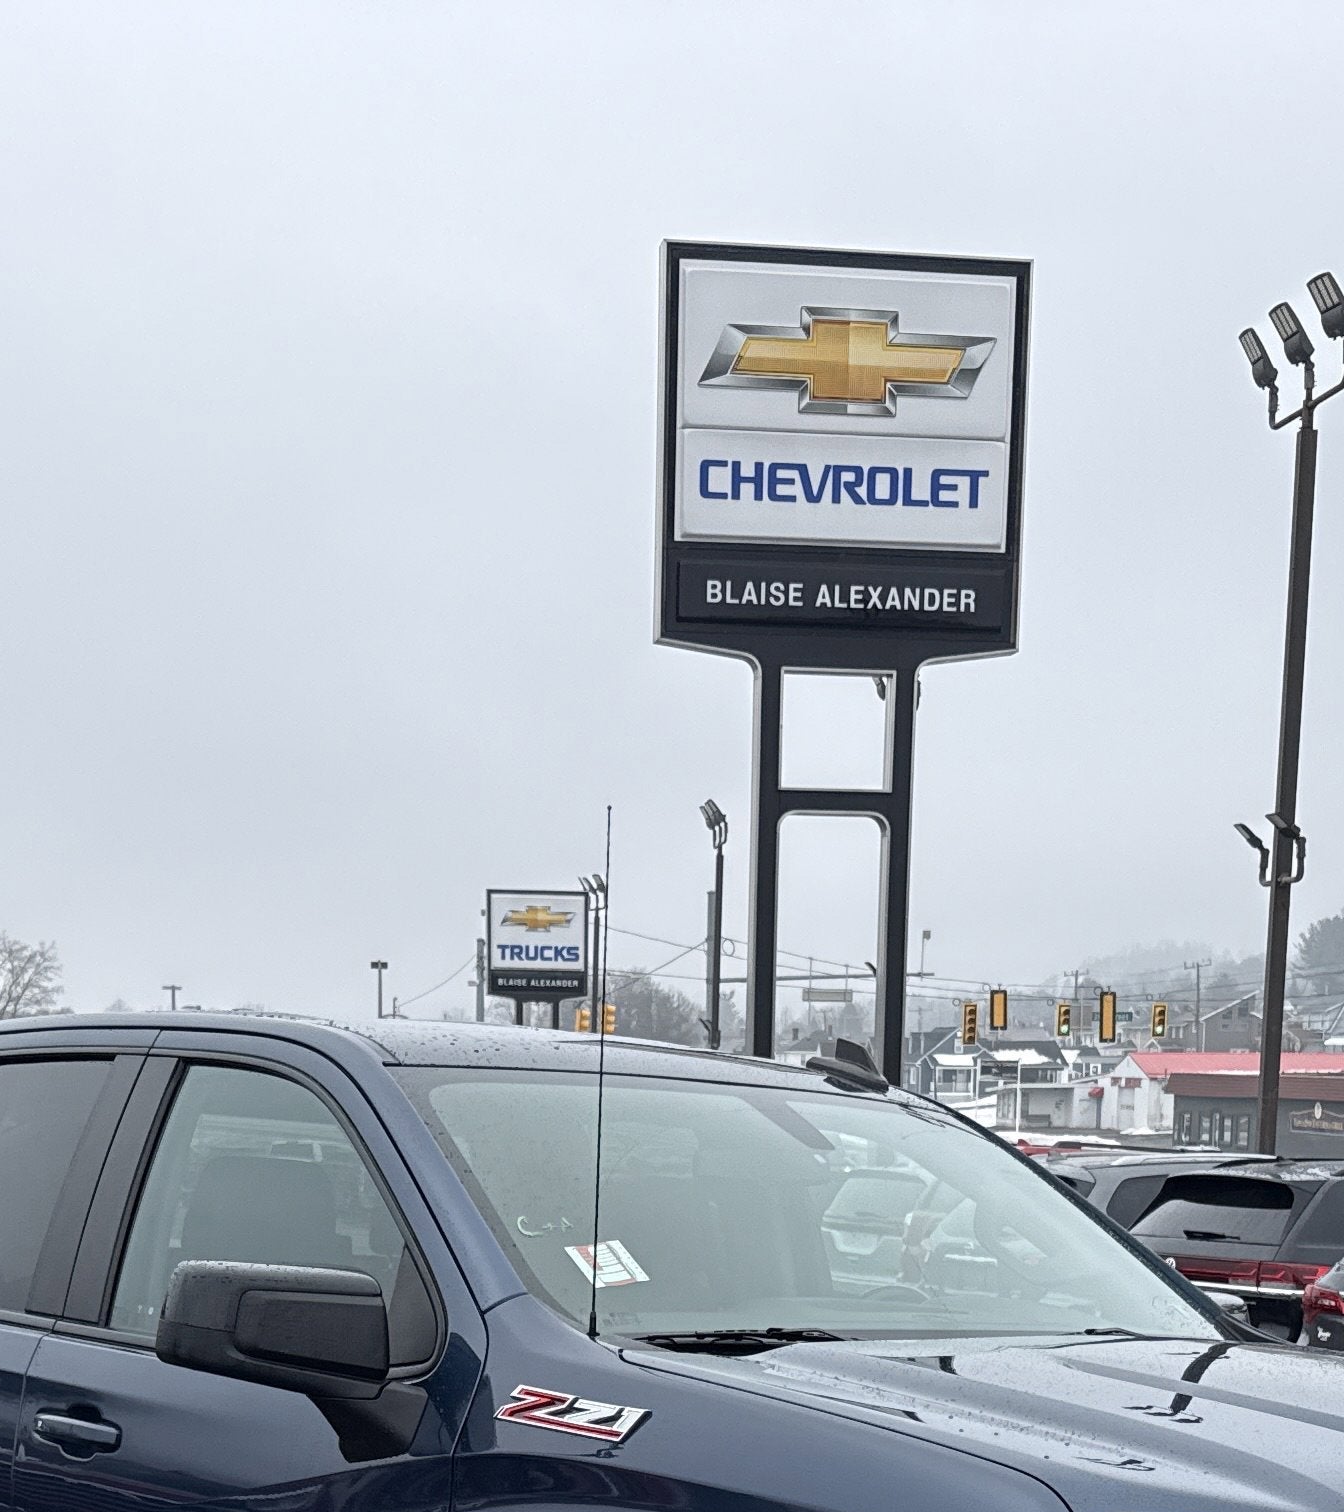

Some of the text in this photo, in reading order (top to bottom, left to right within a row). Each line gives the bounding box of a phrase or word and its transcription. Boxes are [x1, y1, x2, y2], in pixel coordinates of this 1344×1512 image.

[699, 459, 989, 509] CHEVROLET
[706, 580, 976, 613] BLAISE ALEXANDER
[497, 944, 580, 962] TRUCKS
[497, 978, 579, 988] BLAISE ALEXANDER
[494, 1384, 652, 1444] Z71
